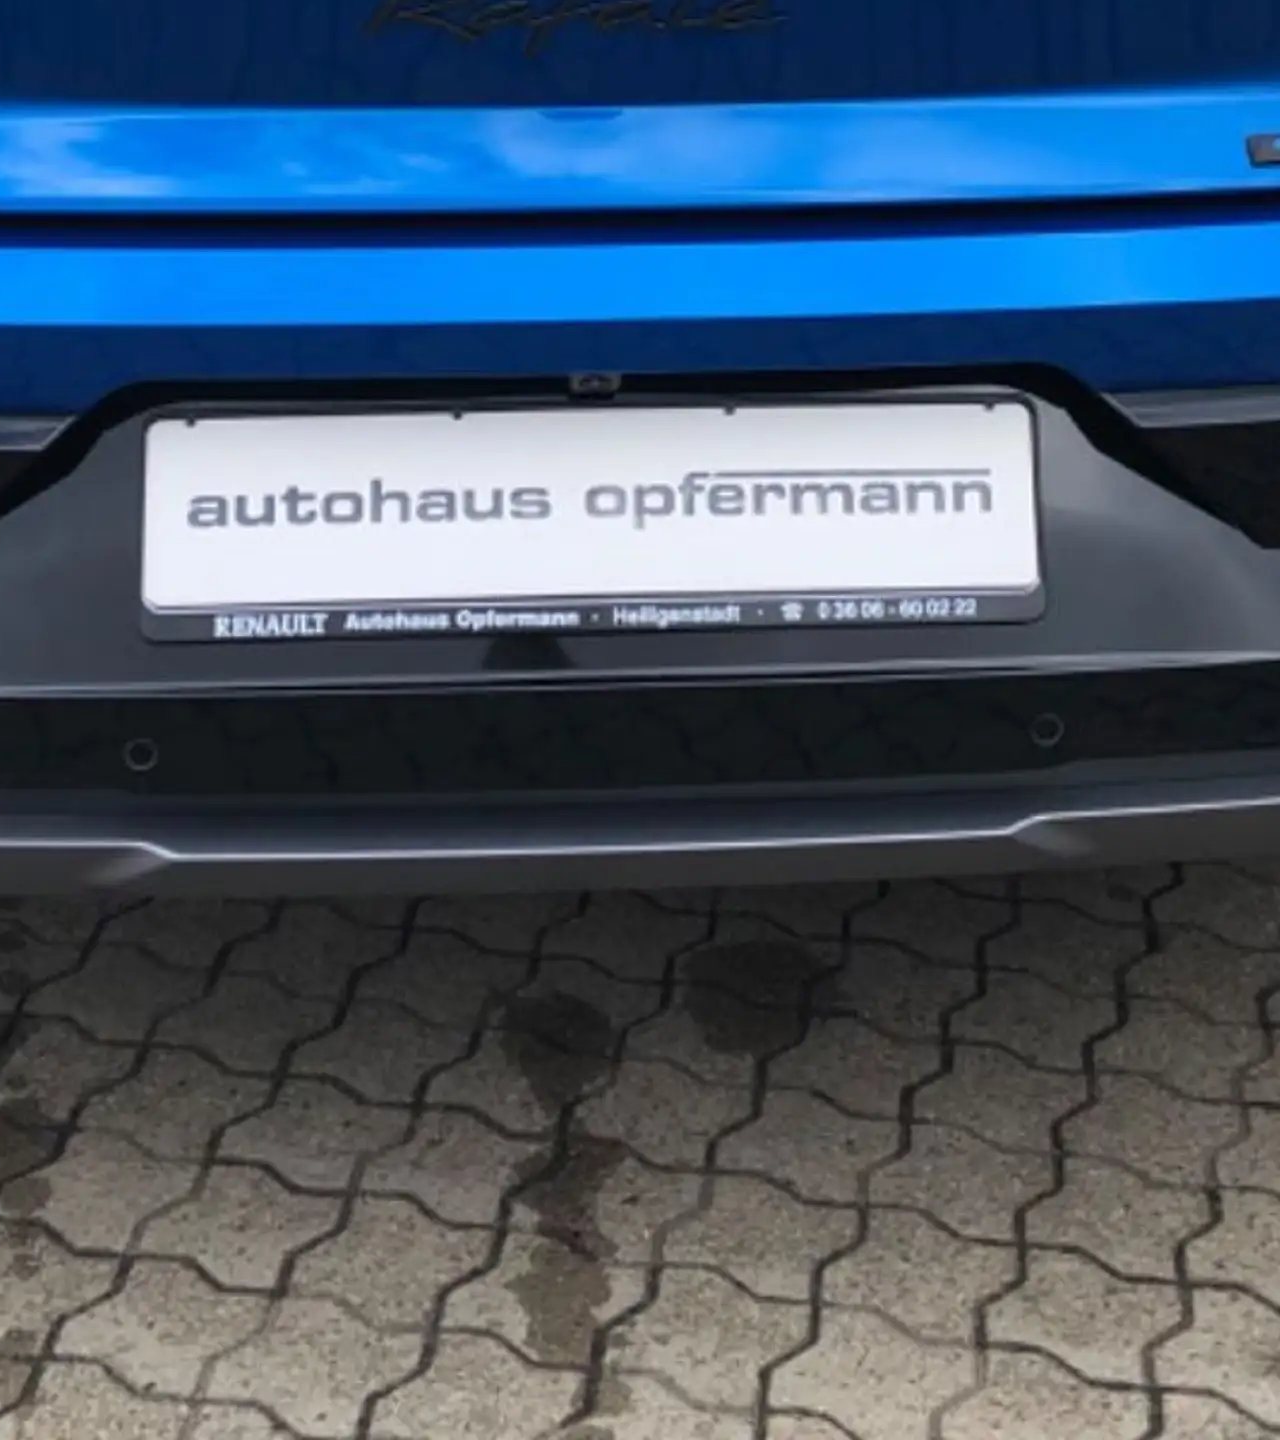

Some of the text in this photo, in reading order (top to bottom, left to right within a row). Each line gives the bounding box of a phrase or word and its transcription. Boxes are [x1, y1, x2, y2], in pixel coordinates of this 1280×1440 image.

[186, 468, 993, 530] autohaus opfermann
[214, 612, 329, 638] RENAULT
[342, 611, 451, 632] Autohaus
[456, 607, 581, 631] Opfermann
